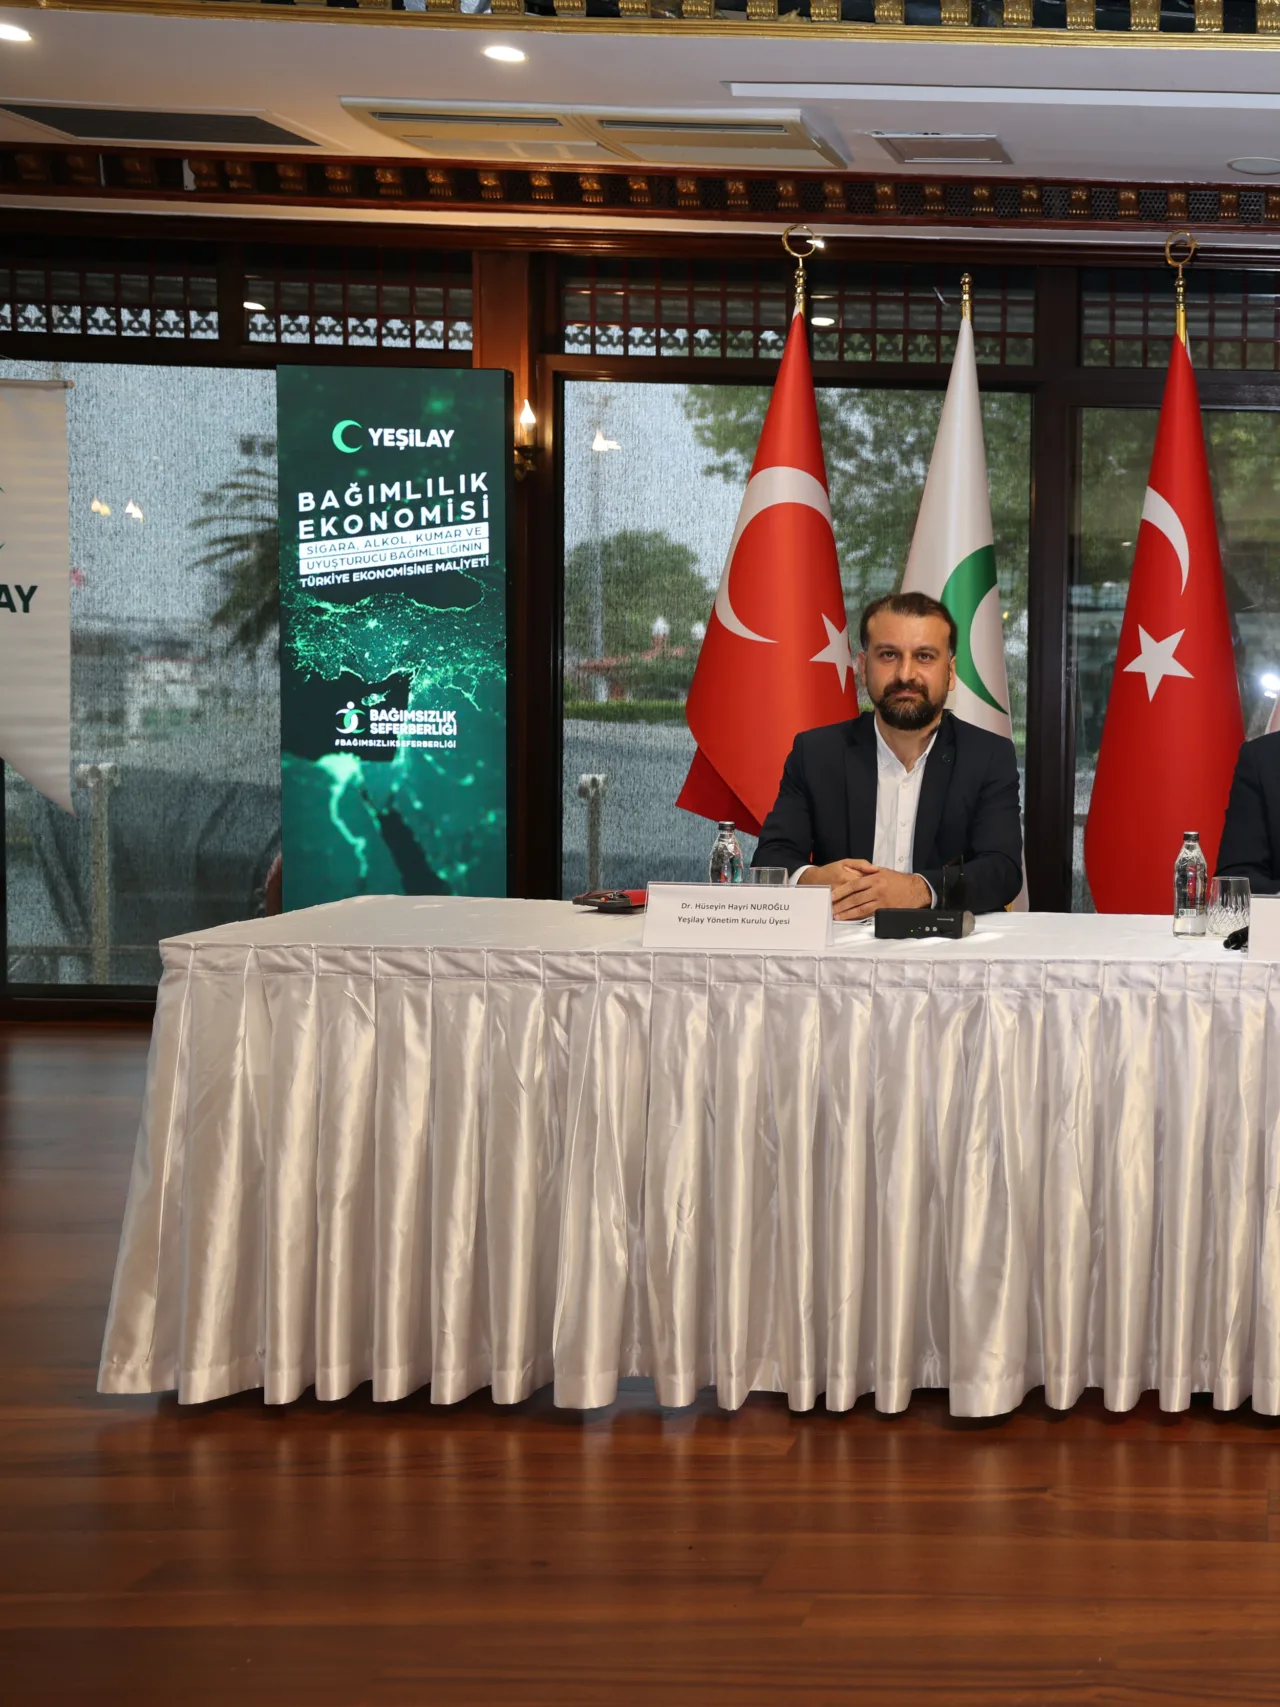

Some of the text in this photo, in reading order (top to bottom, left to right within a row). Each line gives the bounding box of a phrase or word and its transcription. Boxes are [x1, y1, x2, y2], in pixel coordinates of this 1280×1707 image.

[368, 428, 455, 450] YEŞİLAY
[298, 472, 489, 512] BAĞIMLILIK
[298, 494, 489, 540] EKONOMİSİ
[306, 526, 482, 555] SİGARA, ALKOL, KUMAR VE
[307, 542, 482, 570] UYUŞTURUCU BAĞIMLILIĞININ
[300, 555, 490, 588] TÜRKİYE EKONOMİSİNE MALİYETİ
[369, 708, 456, 723] BAĞIMSIZLIK
[369, 720, 457, 735] SEFERBERLİĞİ
[334, 738, 456, 749] #BAĞIMSIZLIKSEFERBERLİĞİ
[681, 901, 790, 912] Dr. Hüseyin Hayri NUROĞLU
[678, 916, 790, 926] Yeşilay Yönetim Kurulu Üyesi
